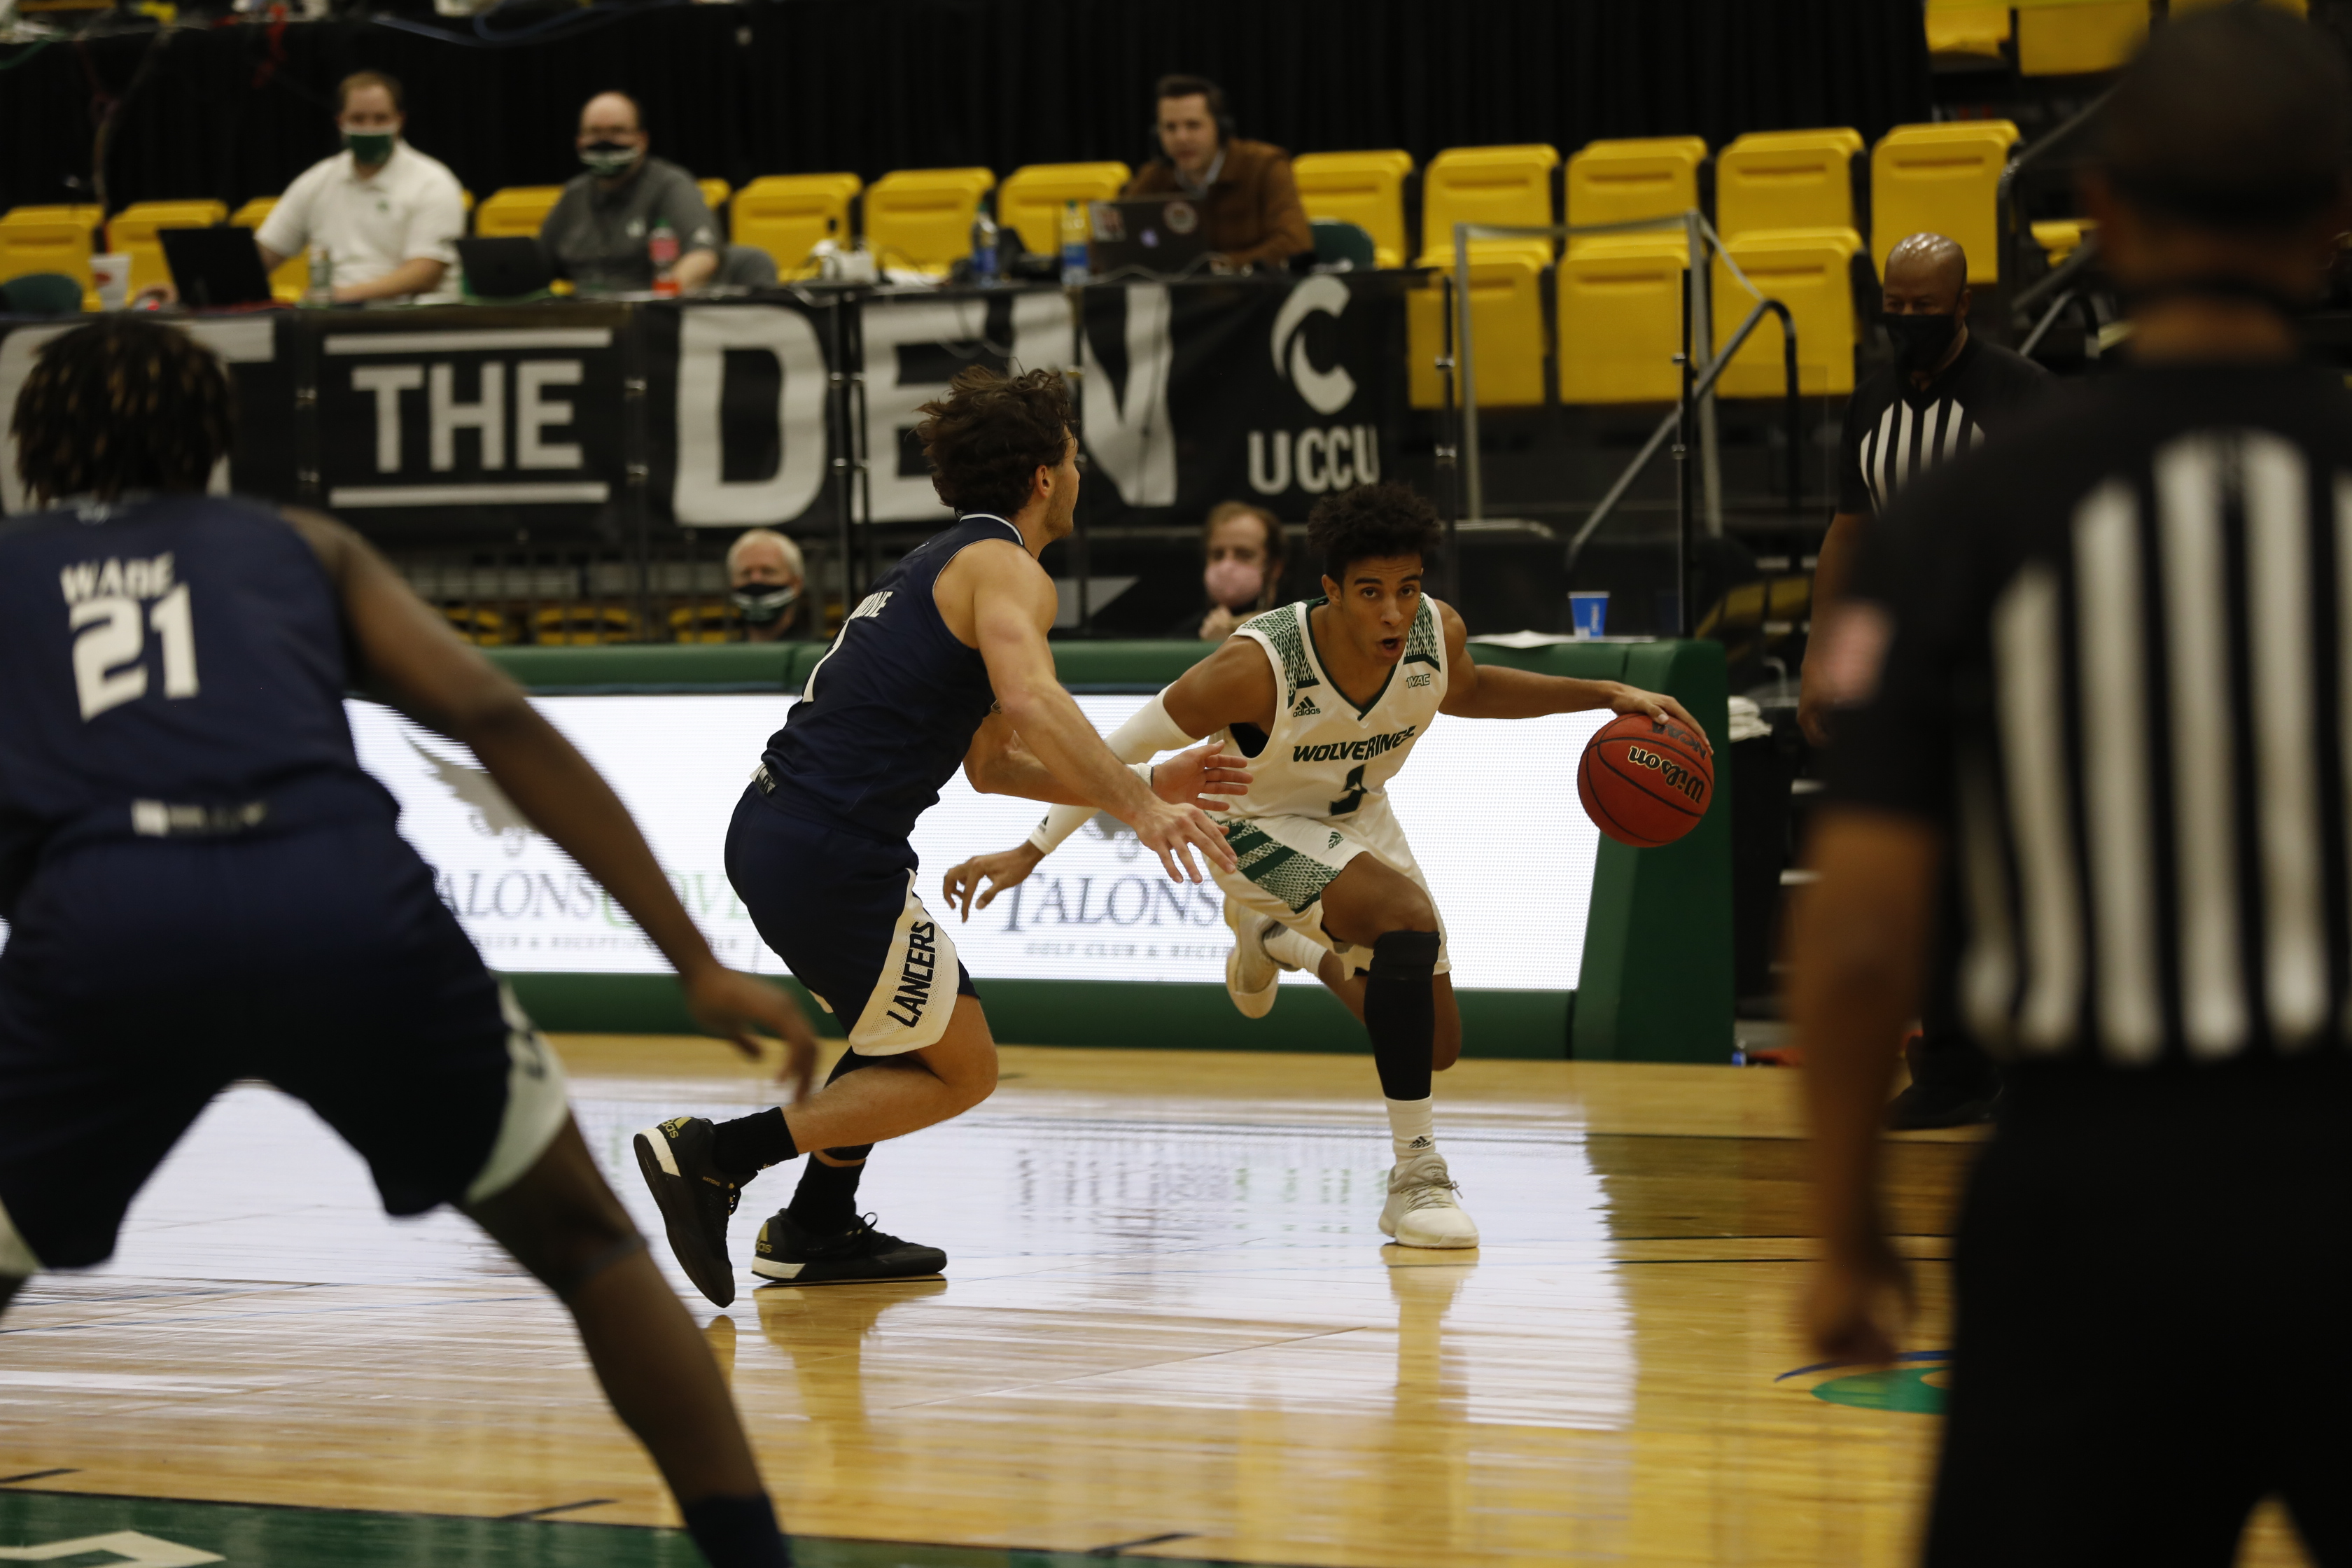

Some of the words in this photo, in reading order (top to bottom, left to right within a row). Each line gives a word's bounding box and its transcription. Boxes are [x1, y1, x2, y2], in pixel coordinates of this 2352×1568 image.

[350, 358, 584, 473] THE
[671, 283, 1177, 528] DEN
[1247, 423, 1381, 496] UCCU
[59, 550, 175, 606] WADE
[69, 581, 201, 724] 21
[1406, 673, 1431, 689] WAC
[1293, 708, 1321, 718] adidas
[1293, 725, 1417, 762] WOLVERINES
[1628, 746, 1705, 804] Wilson
[886, 921, 935, 1028] LANCERS
